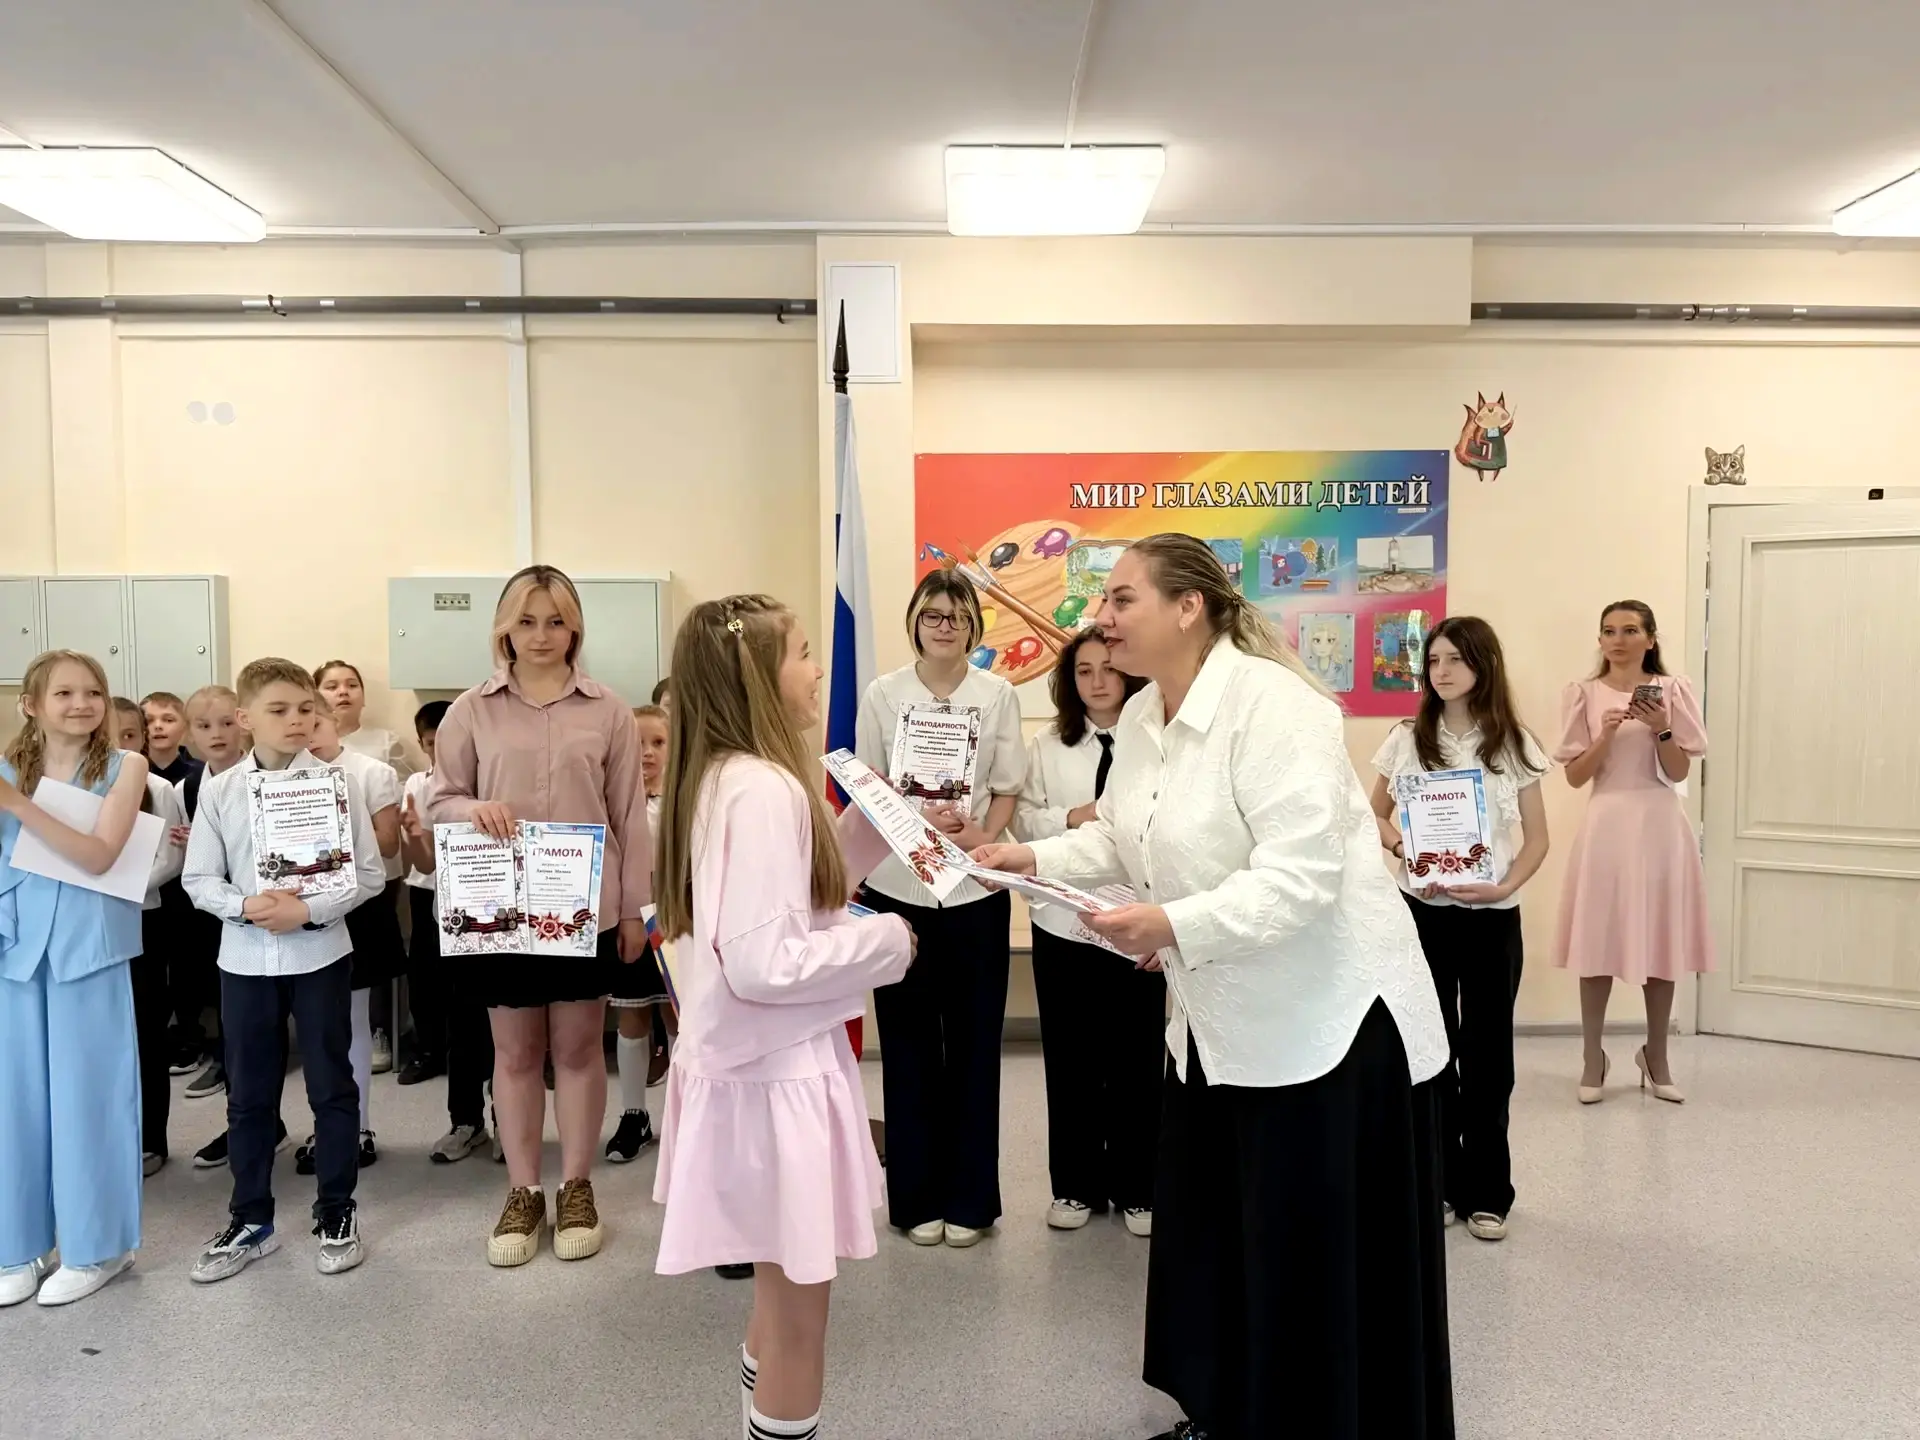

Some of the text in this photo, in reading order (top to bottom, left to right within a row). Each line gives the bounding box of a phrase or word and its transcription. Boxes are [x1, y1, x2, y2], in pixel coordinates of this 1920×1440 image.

[1070, 475, 1432, 512] МИР ГЛАЗАМИ ДЕТЕЙ
[911, 720, 967, 729] БЛАГОДАРНОСТЬ
[265, 789, 332, 799] БЛАГОДАРНОСТЬ
[1421, 792, 1467, 802] ГРАМОТА
[533, 848, 583, 857] ГРАМОТА
